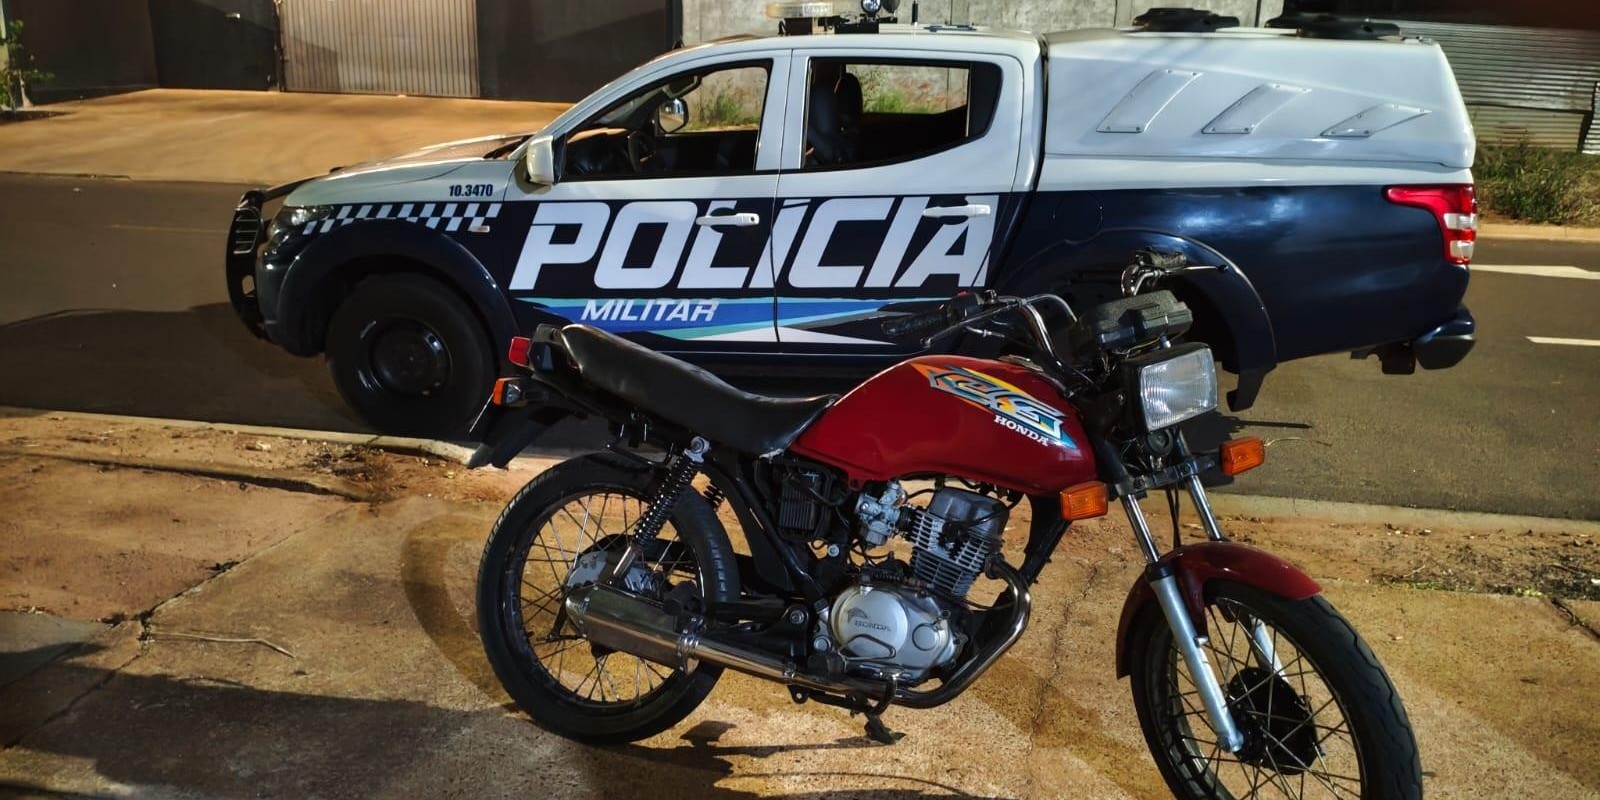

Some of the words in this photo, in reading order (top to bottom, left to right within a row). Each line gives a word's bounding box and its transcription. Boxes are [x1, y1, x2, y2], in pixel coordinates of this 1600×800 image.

[449, 184, 493, 197] 10.3470
[581, 298, 720, 322] MILITAR
[994, 414, 1049, 447] HONDA
